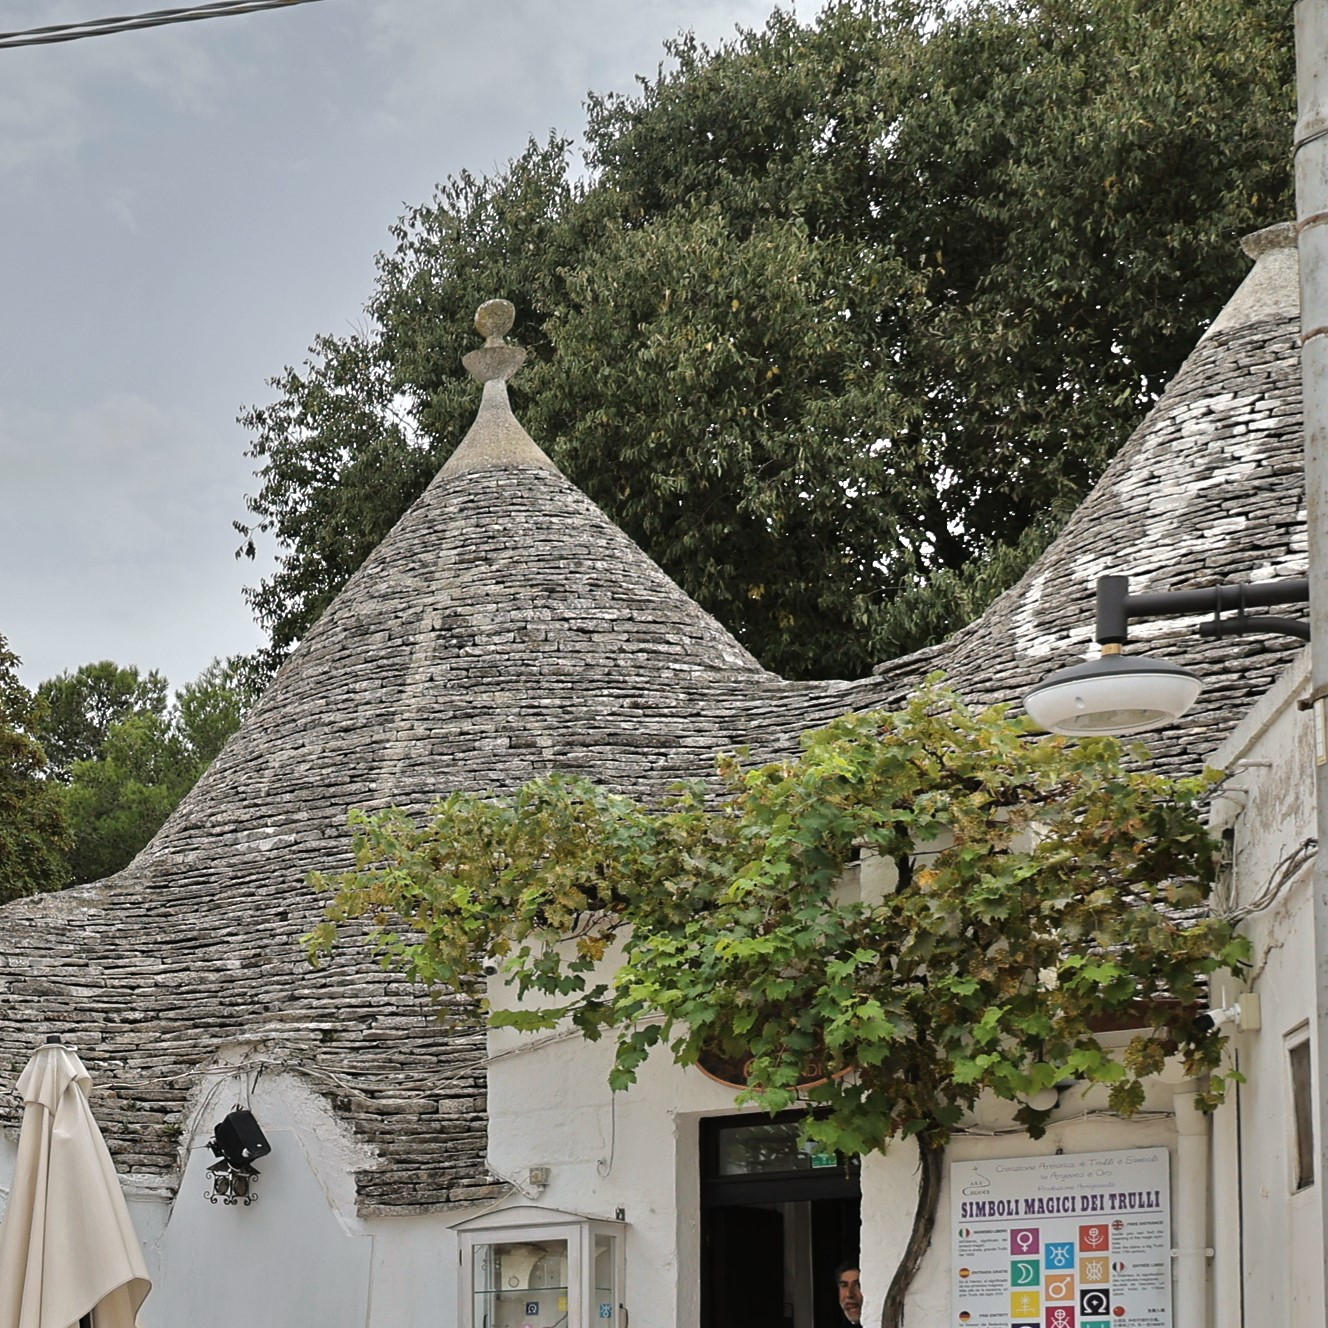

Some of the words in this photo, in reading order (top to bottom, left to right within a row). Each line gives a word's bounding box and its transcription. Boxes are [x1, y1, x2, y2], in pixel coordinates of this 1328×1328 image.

[961, 1199, 1019, 1218] SIMBOLI
[1024, 1195, 1078, 1215] MAGICI
[1081, 1193, 1104, 1211] DEI
[1109, 1190, 1161, 1210] TRULLI
